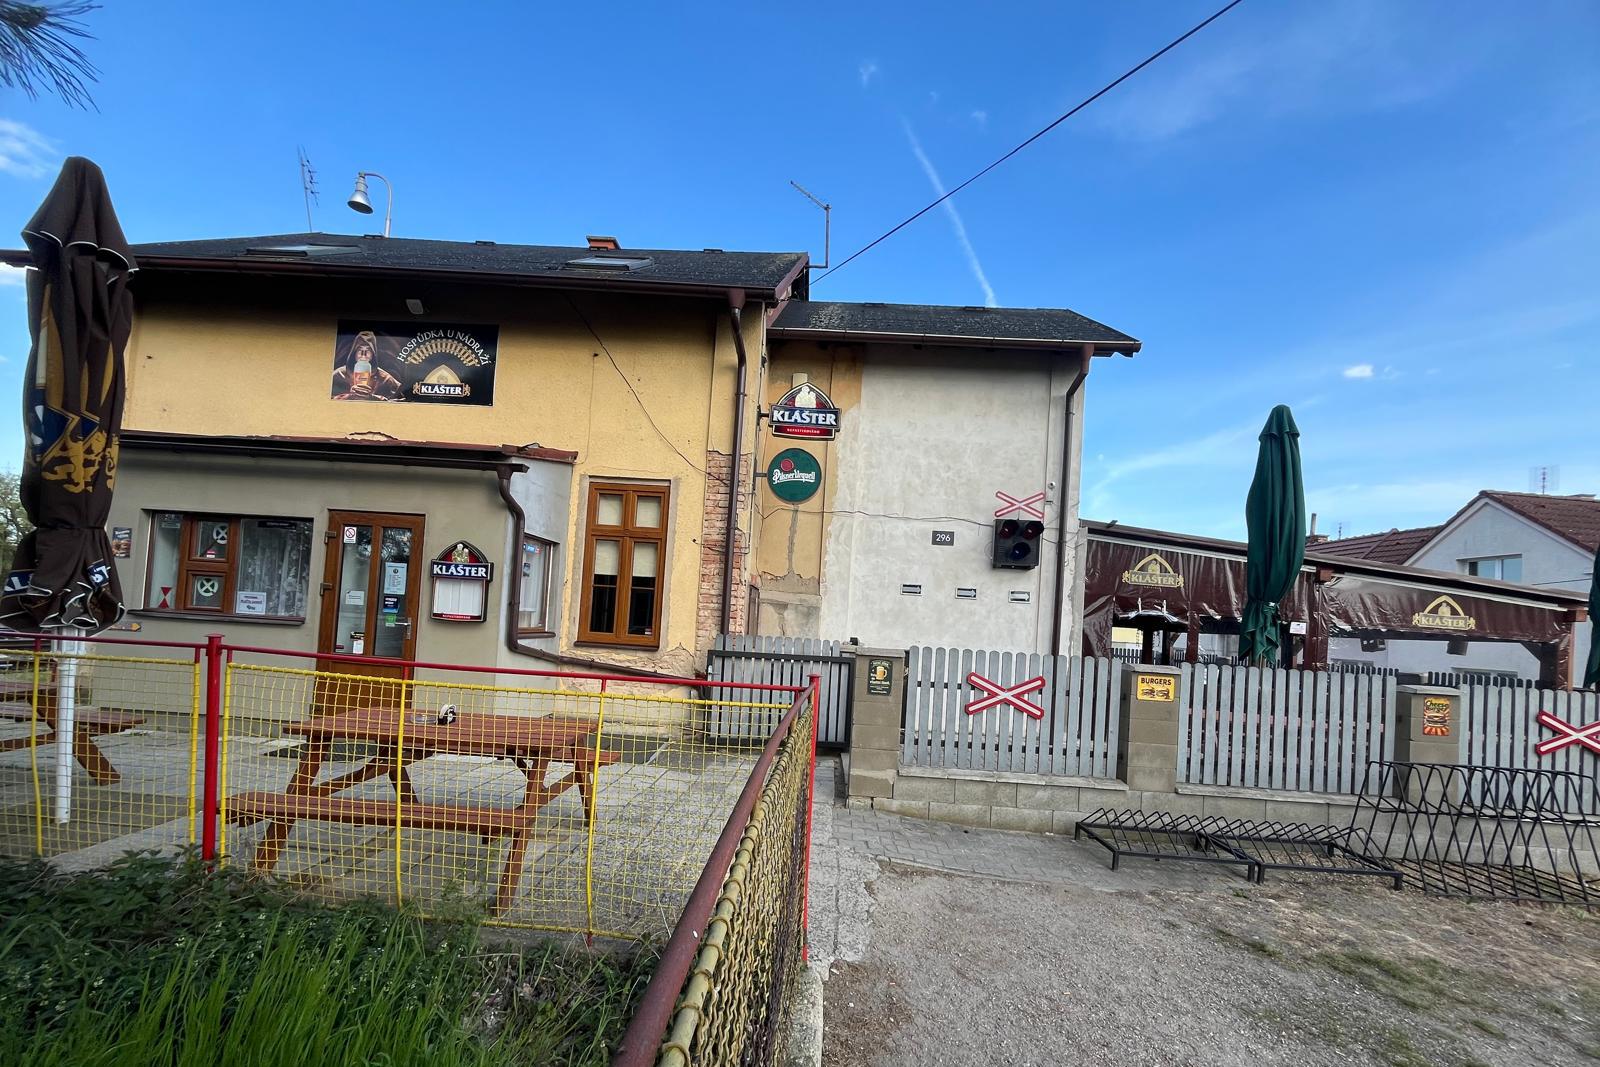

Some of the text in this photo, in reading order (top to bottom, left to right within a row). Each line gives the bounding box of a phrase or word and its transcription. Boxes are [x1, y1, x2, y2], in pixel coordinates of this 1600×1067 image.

[447, 330, 455, 338] U
[455, 330, 492, 366] NÁDRAŽÍ
[421, 383, 463, 395] KLÁŠTER
[772, 409, 837, 425] KLÁŠTER
[772, 468, 816, 485] Pilsner Urquell
[935, 533, 951, 542] 296
[433, 564, 487, 577] KLÁŠTER
[1140, 677, 1172, 687] BURGERS
